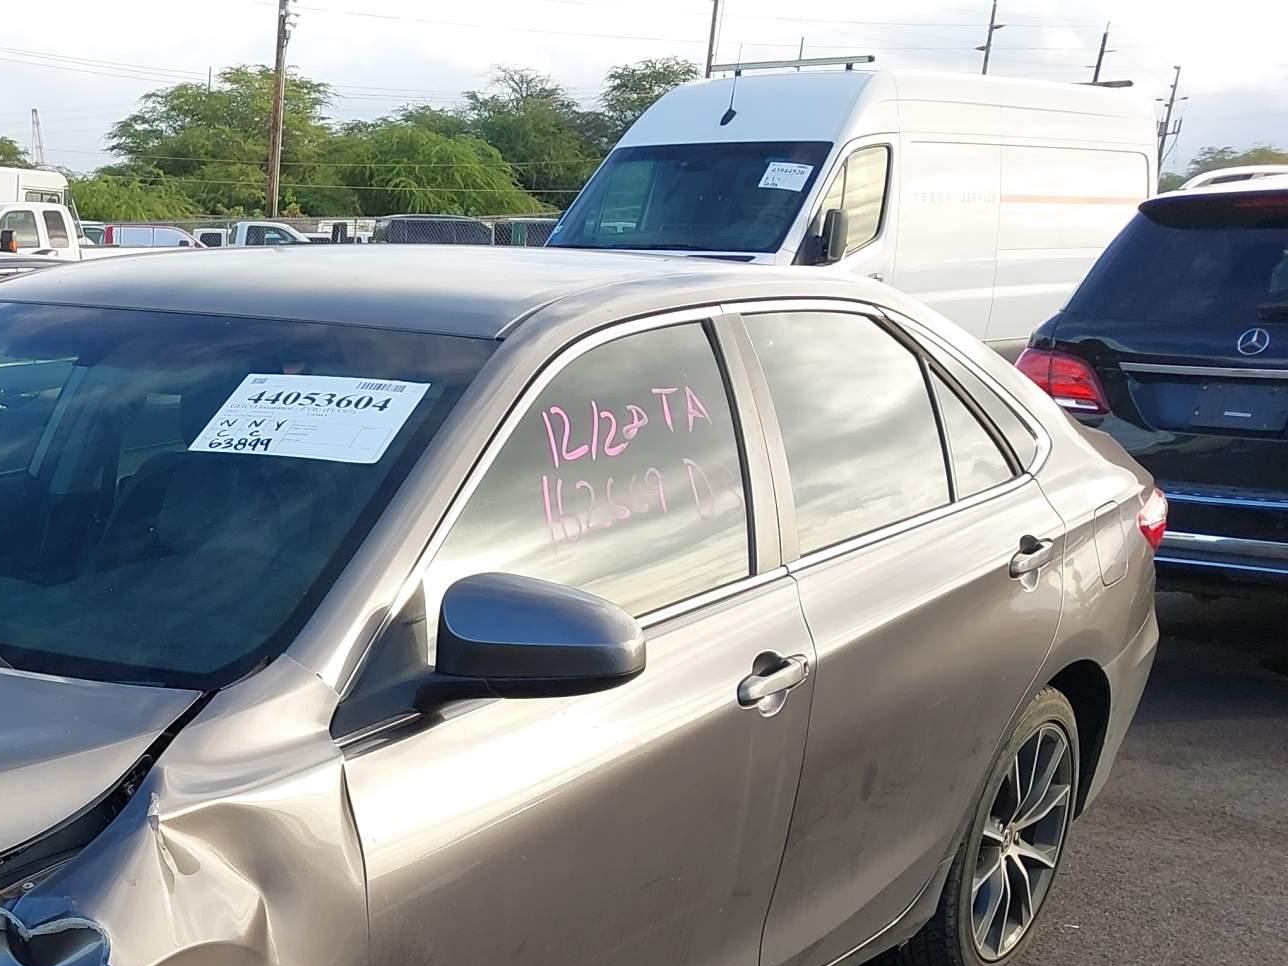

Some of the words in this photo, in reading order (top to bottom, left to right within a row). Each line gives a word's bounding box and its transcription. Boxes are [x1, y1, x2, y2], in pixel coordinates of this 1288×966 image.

[961, 192, 1000, 203] SERVICE
[247, 390, 393, 412] 44053604
[208, 437, 273, 452] 63899
